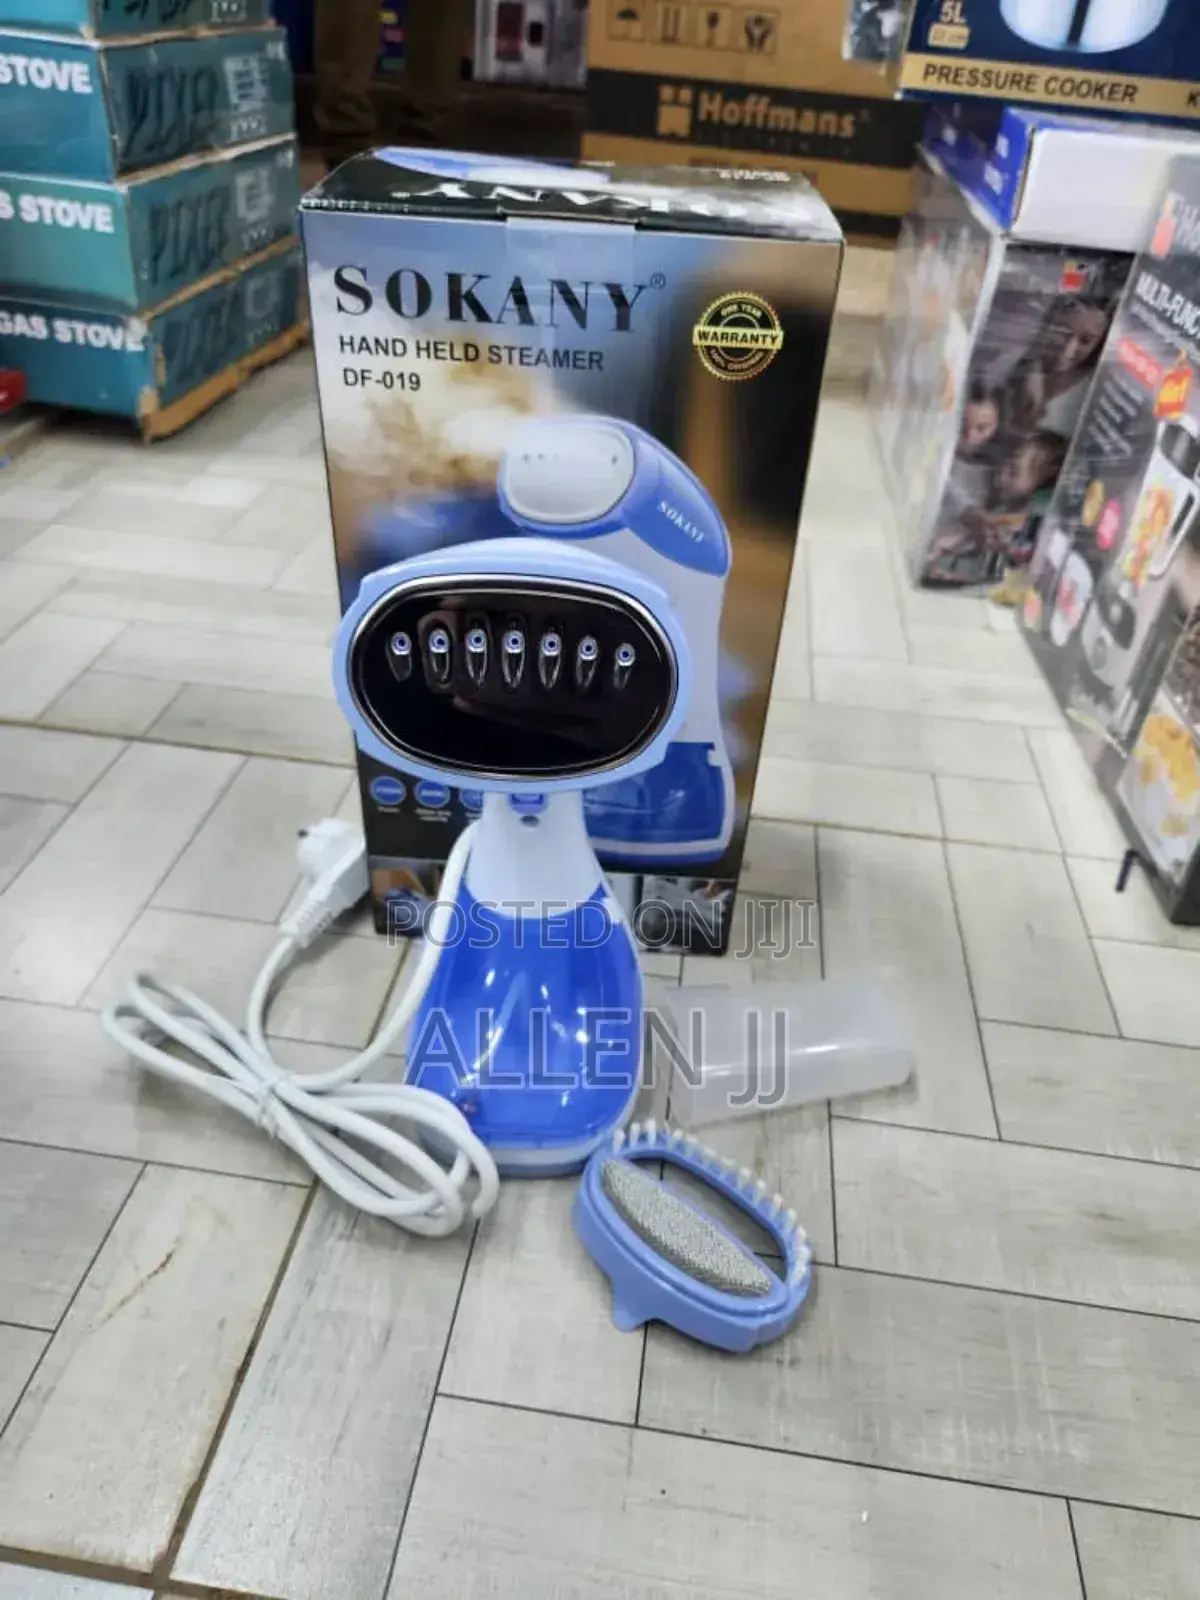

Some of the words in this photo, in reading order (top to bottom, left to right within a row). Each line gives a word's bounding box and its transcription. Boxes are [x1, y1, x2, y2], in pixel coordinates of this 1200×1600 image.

[0, 54, 92, 94] STOVE
[922, 63, 1038, 93] PRESSURE
[1043, 75, 1138, 103] COOKER
[698, 91, 855, 138] Hoffmans
[18, 194, 115, 234] STOVE
[334, 264, 648, 333] SOKANY
[53, 316, 145, 352] STOVE
[338, 335, 407, 358] HAND
[415, 343, 481, 363] HELD
[487, 345, 604, 372] STEAMER
[698, 330, 779, 347] WARRANTY
[342, 367, 421, 391] DF-019
